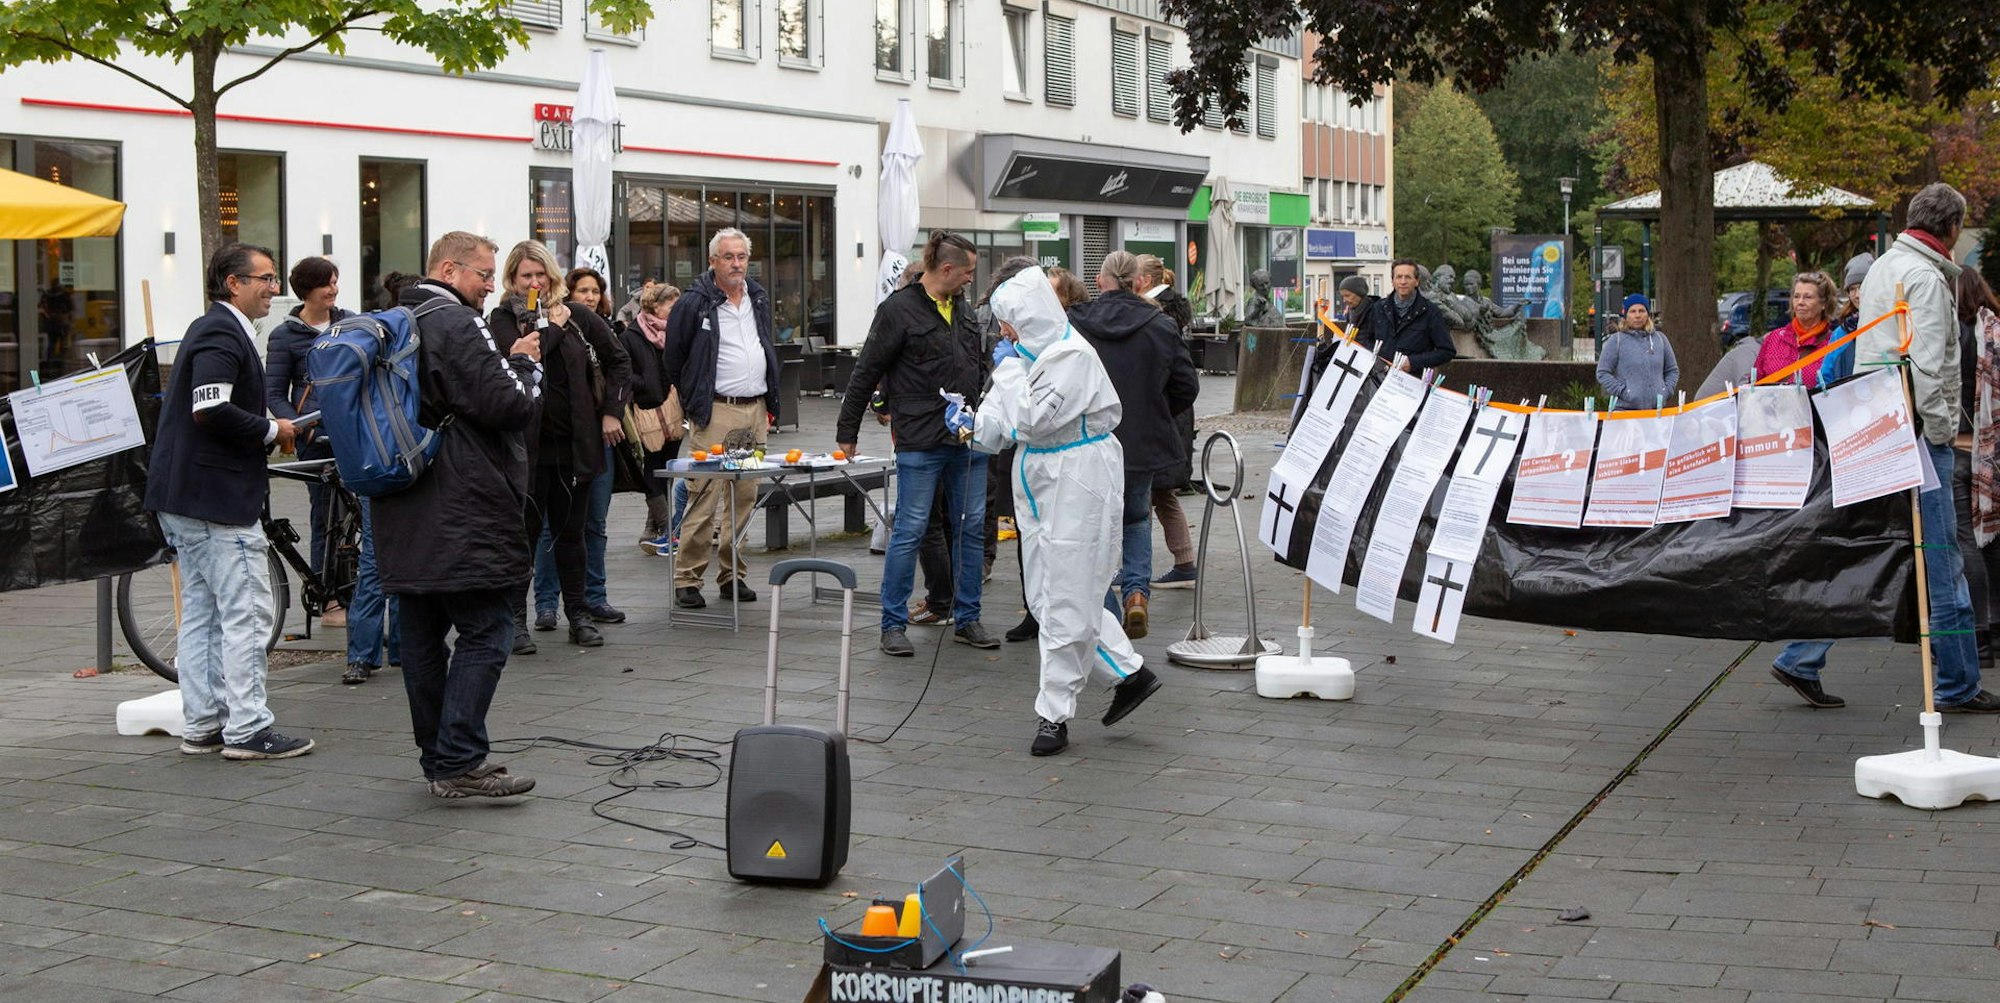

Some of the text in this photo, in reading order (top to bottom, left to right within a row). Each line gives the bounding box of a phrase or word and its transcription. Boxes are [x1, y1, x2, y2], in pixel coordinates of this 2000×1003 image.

[541, 106, 574, 119] CAF
[1502, 256, 1514, 265] Bei
[1502, 266, 1554, 274] trainieren Sie
[1502, 275, 1549, 283] mit Abstand
[1516, 284, 1545, 293] besten.
[1740, 427, 1796, 457] Immun ?
[1676, 450, 1706, 466] gefährlich
[1706, 445, 1717, 453] wie
[1668, 467, 1681, 476] eine
[1682, 456, 1711, 471] Autofahrt
[831, 971, 943, 1003] KORRUPTE
